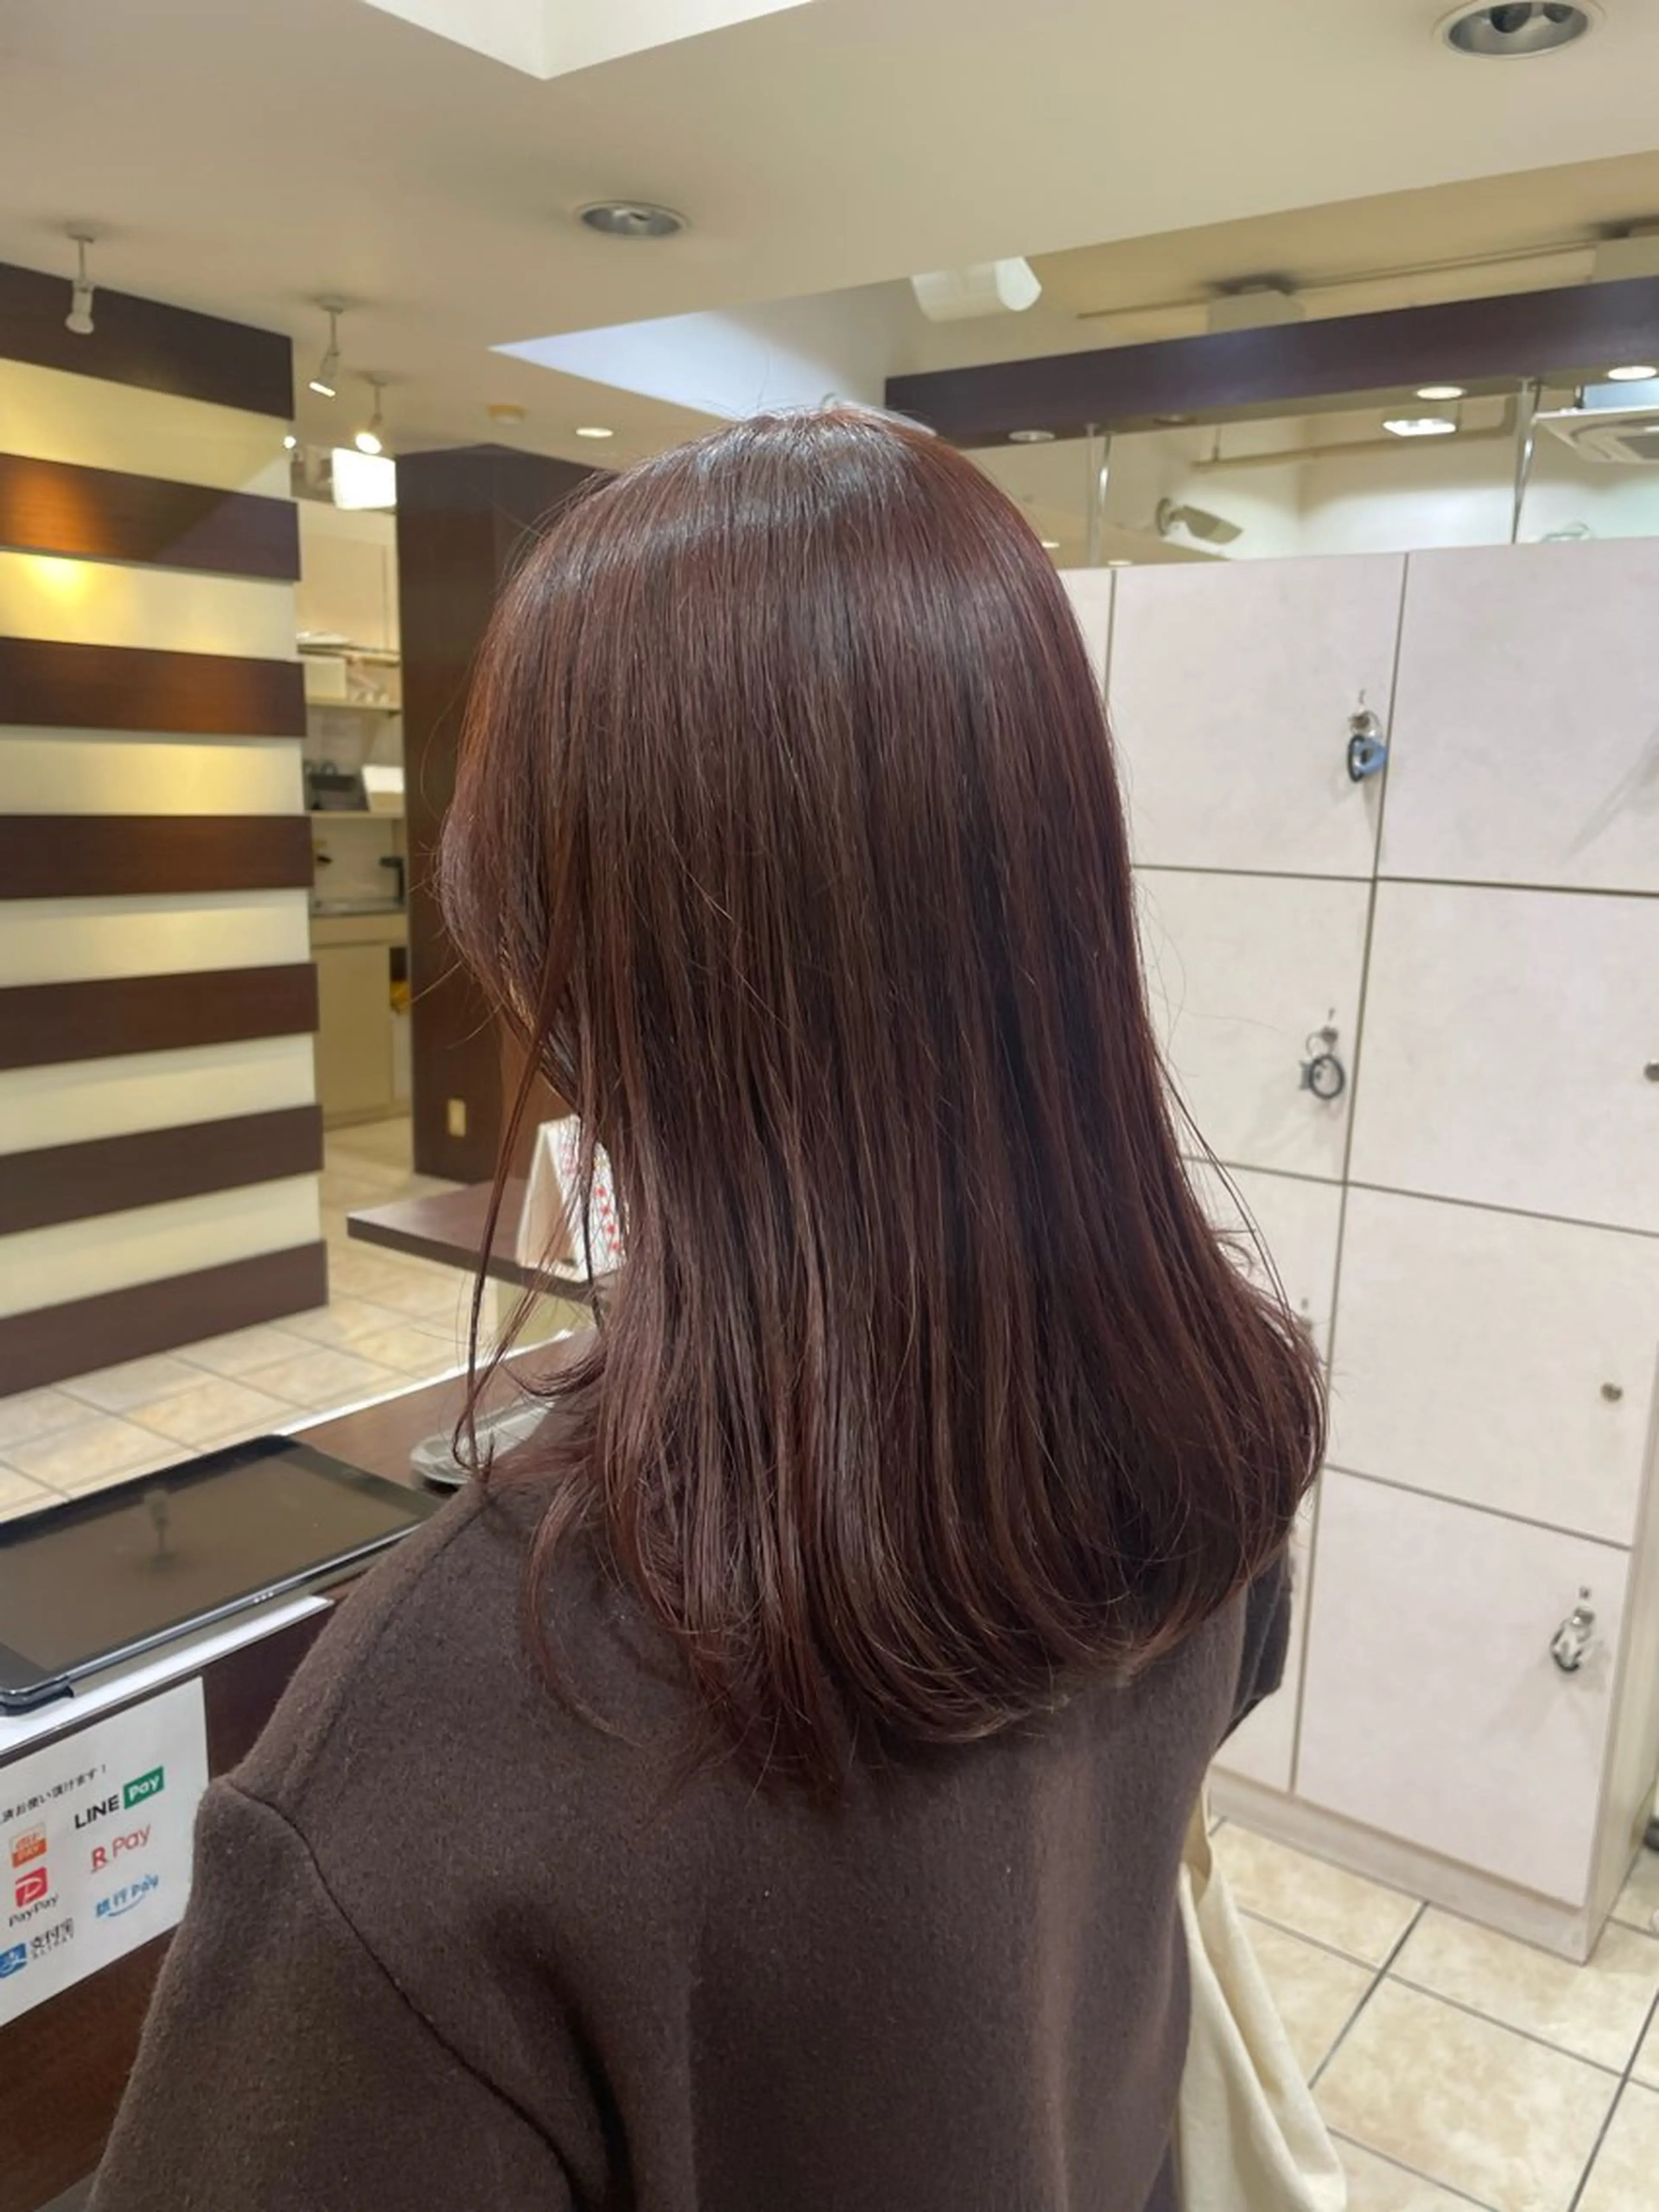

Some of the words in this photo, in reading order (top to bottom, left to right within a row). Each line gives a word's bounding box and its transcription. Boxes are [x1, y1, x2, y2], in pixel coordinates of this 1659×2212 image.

[74, 1793, 120, 1829] LINE
[112, 1823, 151, 1858] Pay
[9, 1893, 59, 1927] PayPay
